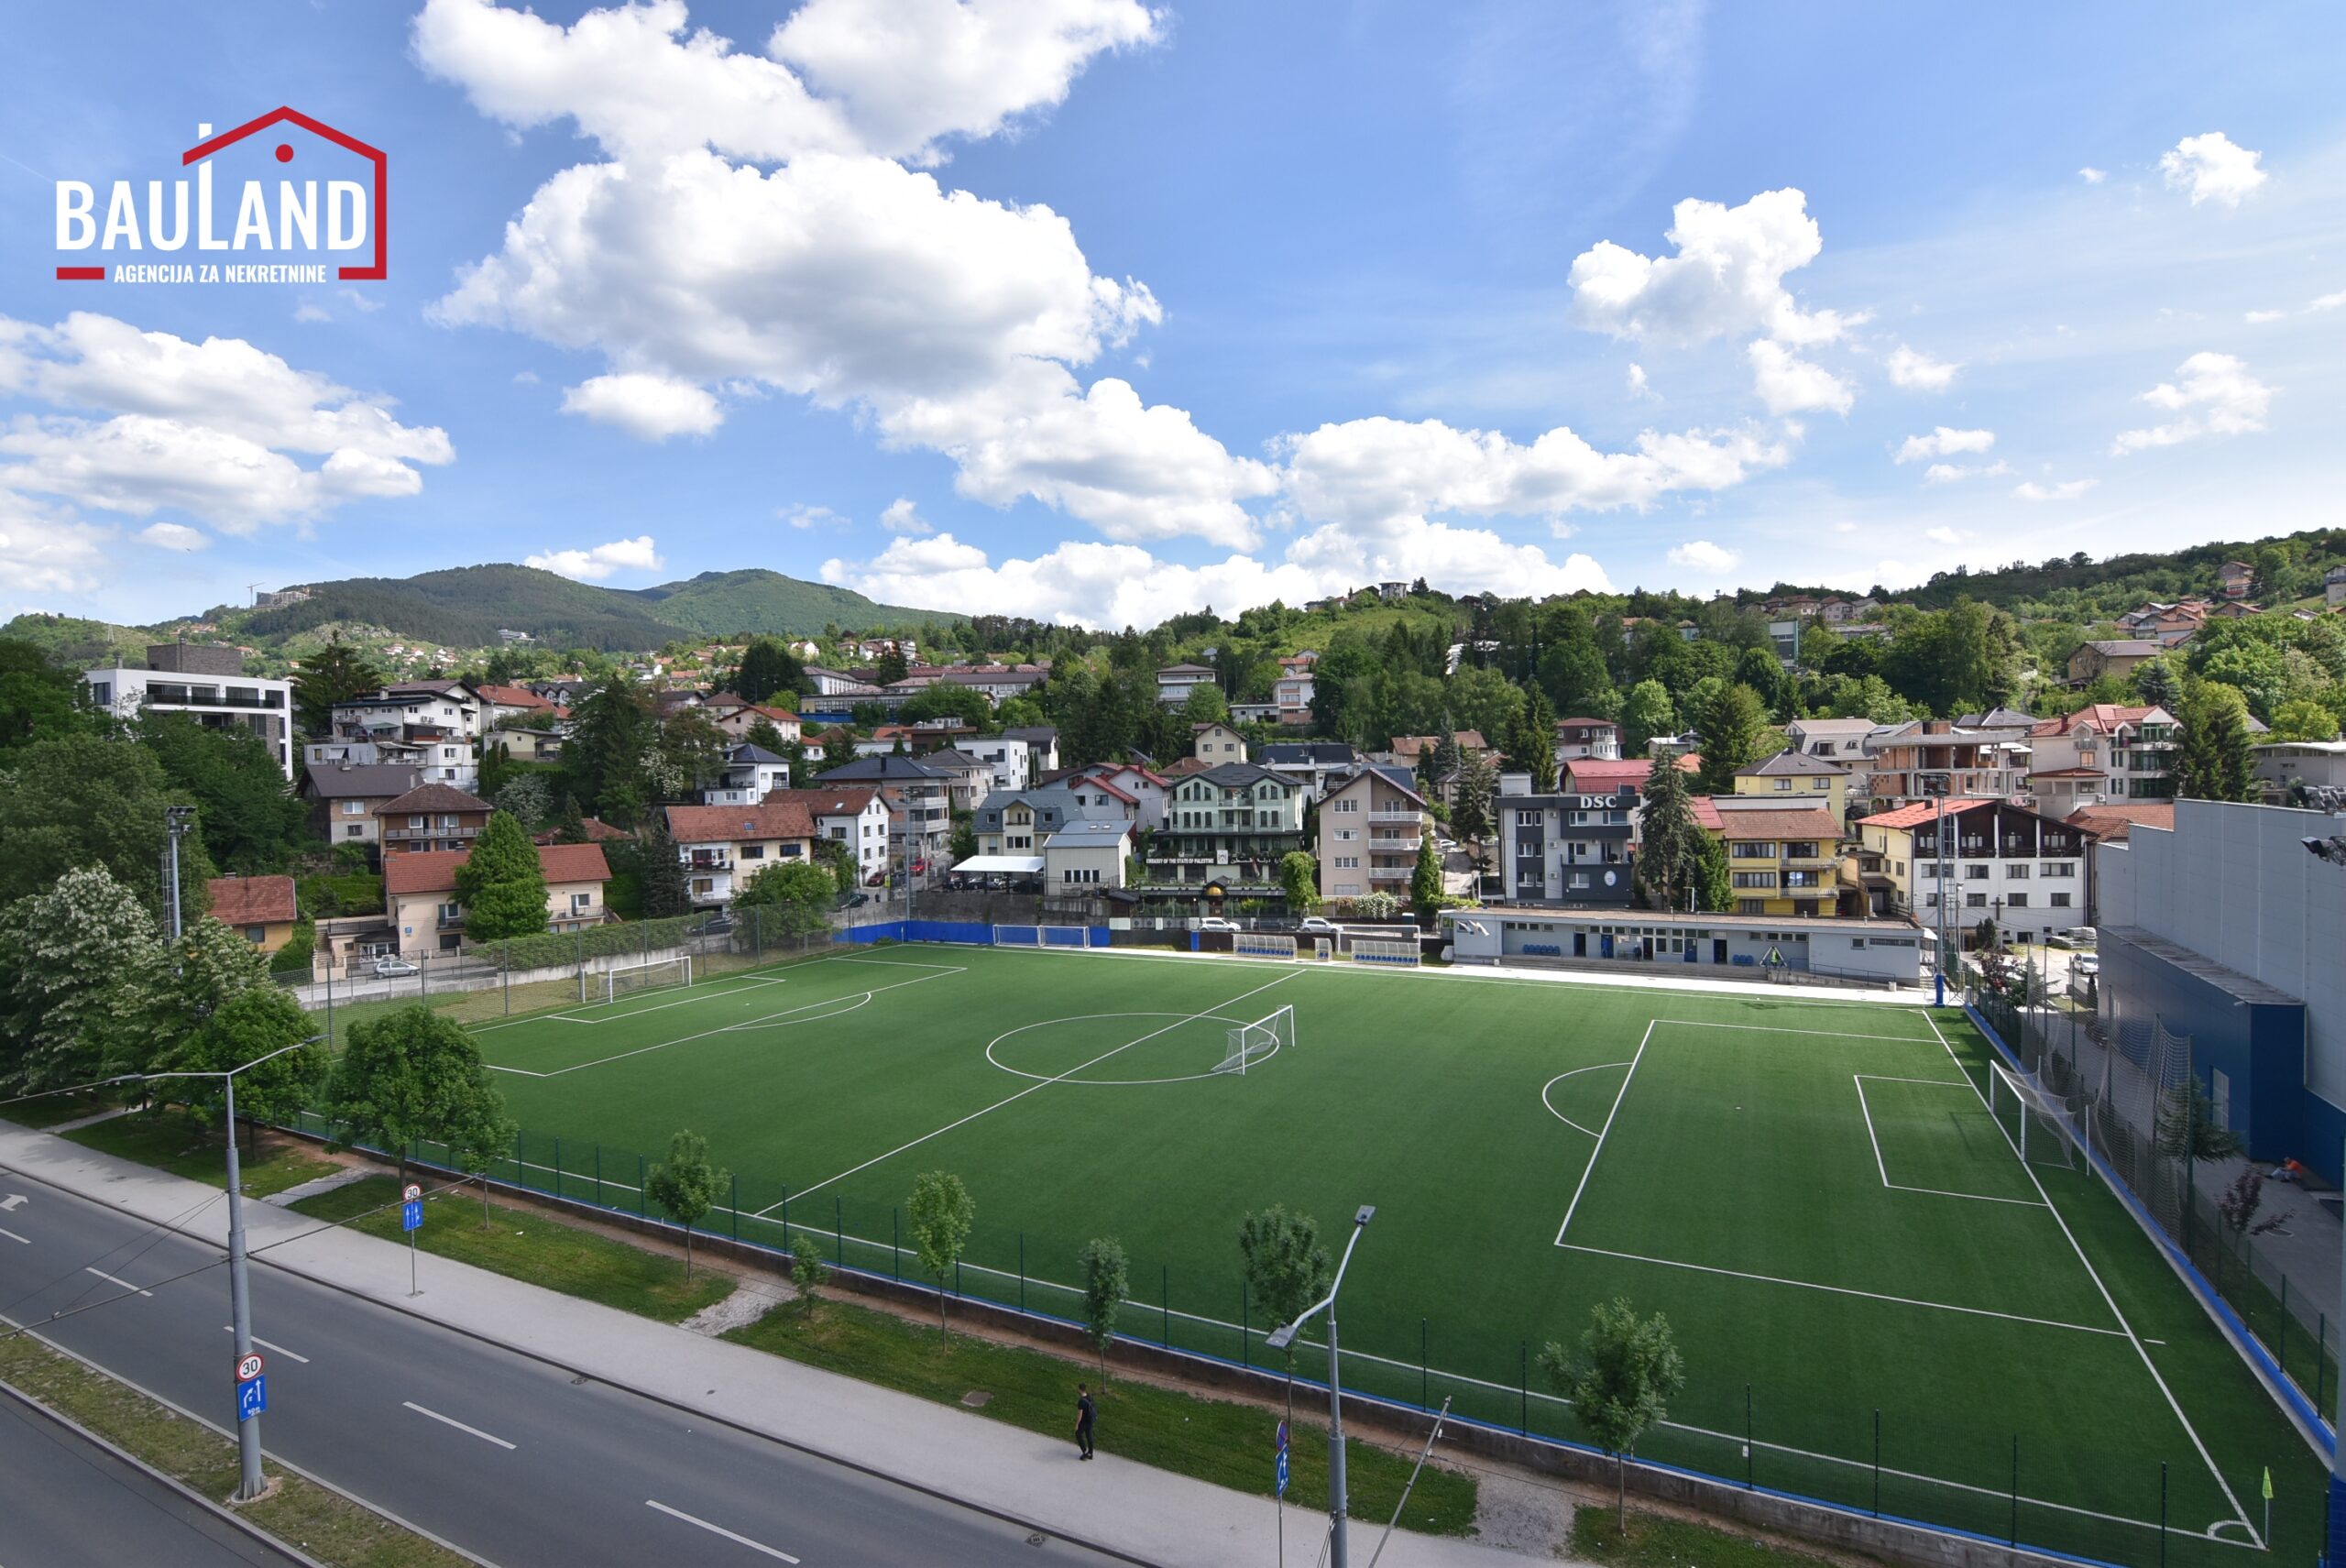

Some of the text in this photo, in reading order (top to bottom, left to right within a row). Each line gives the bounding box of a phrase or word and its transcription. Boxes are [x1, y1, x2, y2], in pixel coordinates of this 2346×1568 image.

[1580, 795, 1617, 808] DSC
[407, 1188, 418, 1198] 30
[243, 1359, 258, 1375] 30
